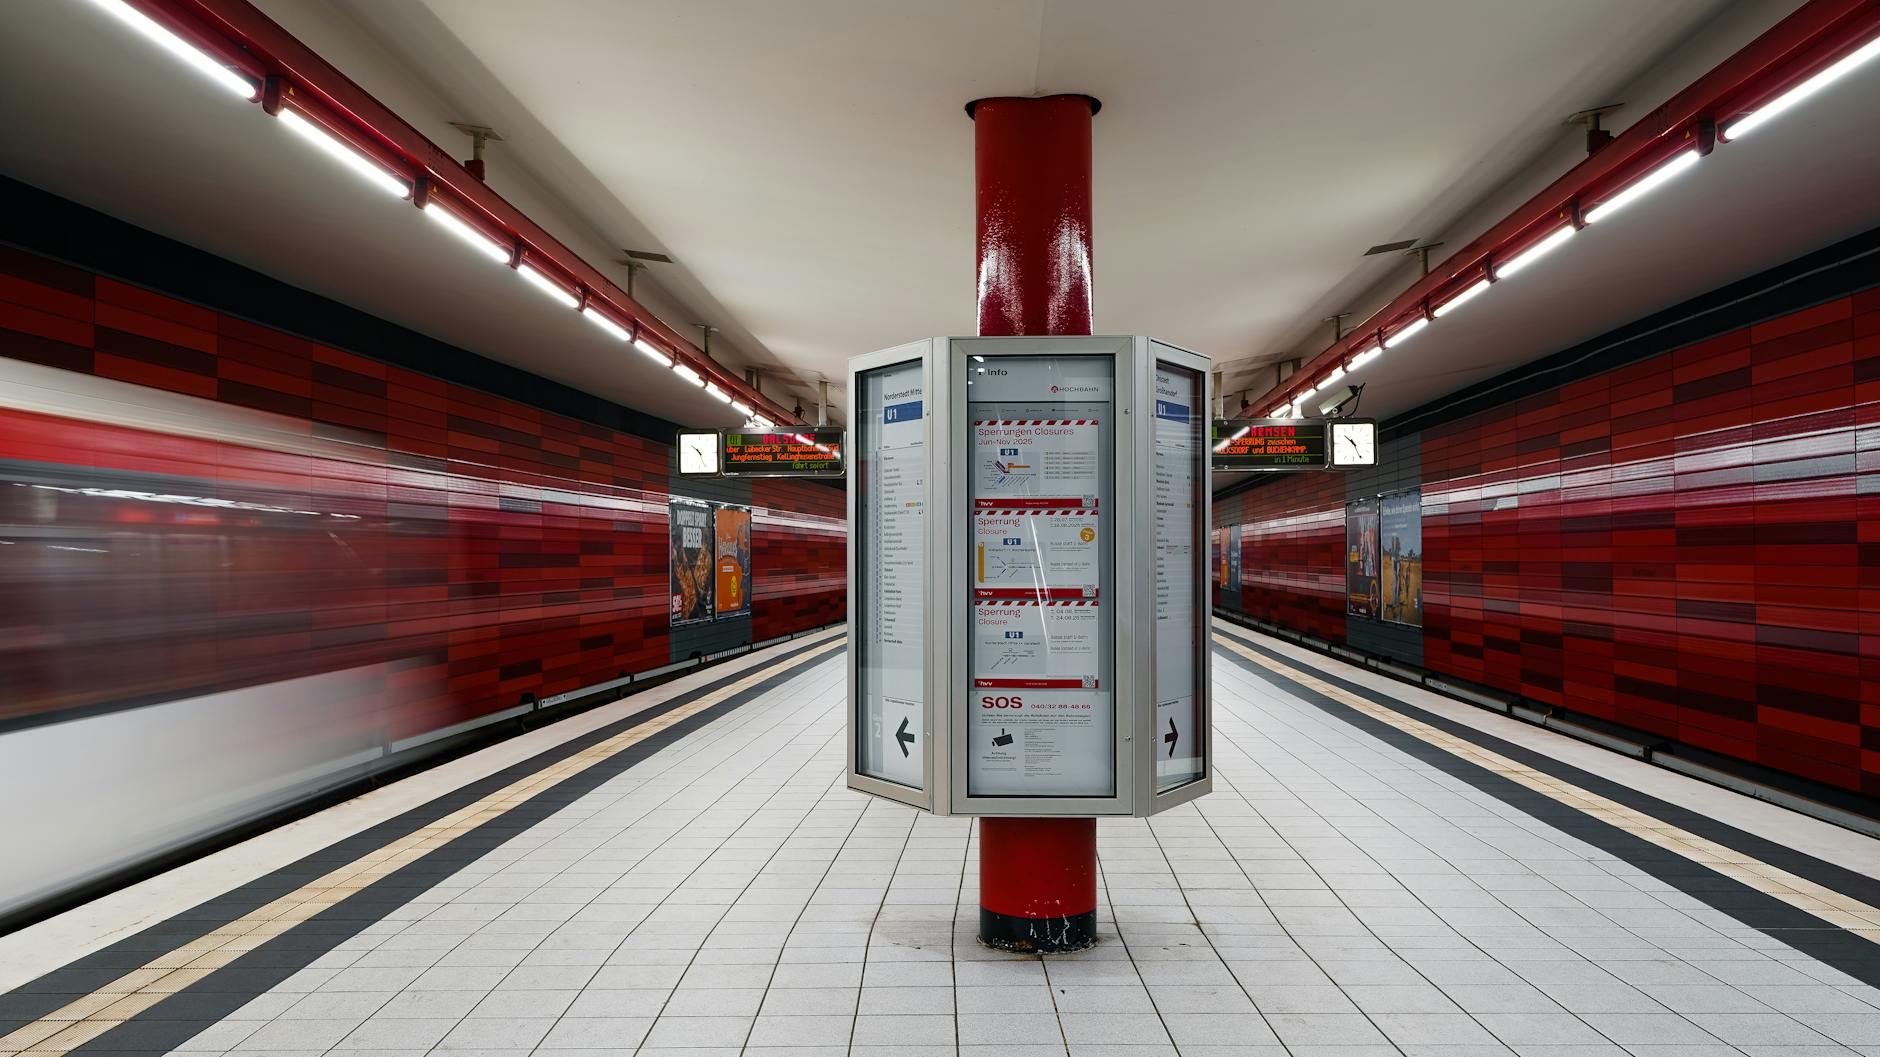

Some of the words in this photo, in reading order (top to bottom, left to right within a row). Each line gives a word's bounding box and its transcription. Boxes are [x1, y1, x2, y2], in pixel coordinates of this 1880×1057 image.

[987, 368, 1008, 376] Info
[887, 408, 897, 421] U1
[1158, 403, 1166, 416] U1
[978, 428, 1032, 437] Sperrungen
[1034, 427, 1075, 436] Closures
[1244, 426, 1296, 437] ARMSEN
[1224, 437, 1265, 446] -SPERRUNG
[787, 444, 828, 456] Hauptbahn
[1252, 446, 1265, 454] und
[978, 517, 1021, 526] Sperrung
[978, 608, 1021, 617] Sperrung
[981, 696, 1023, 709] SOS
